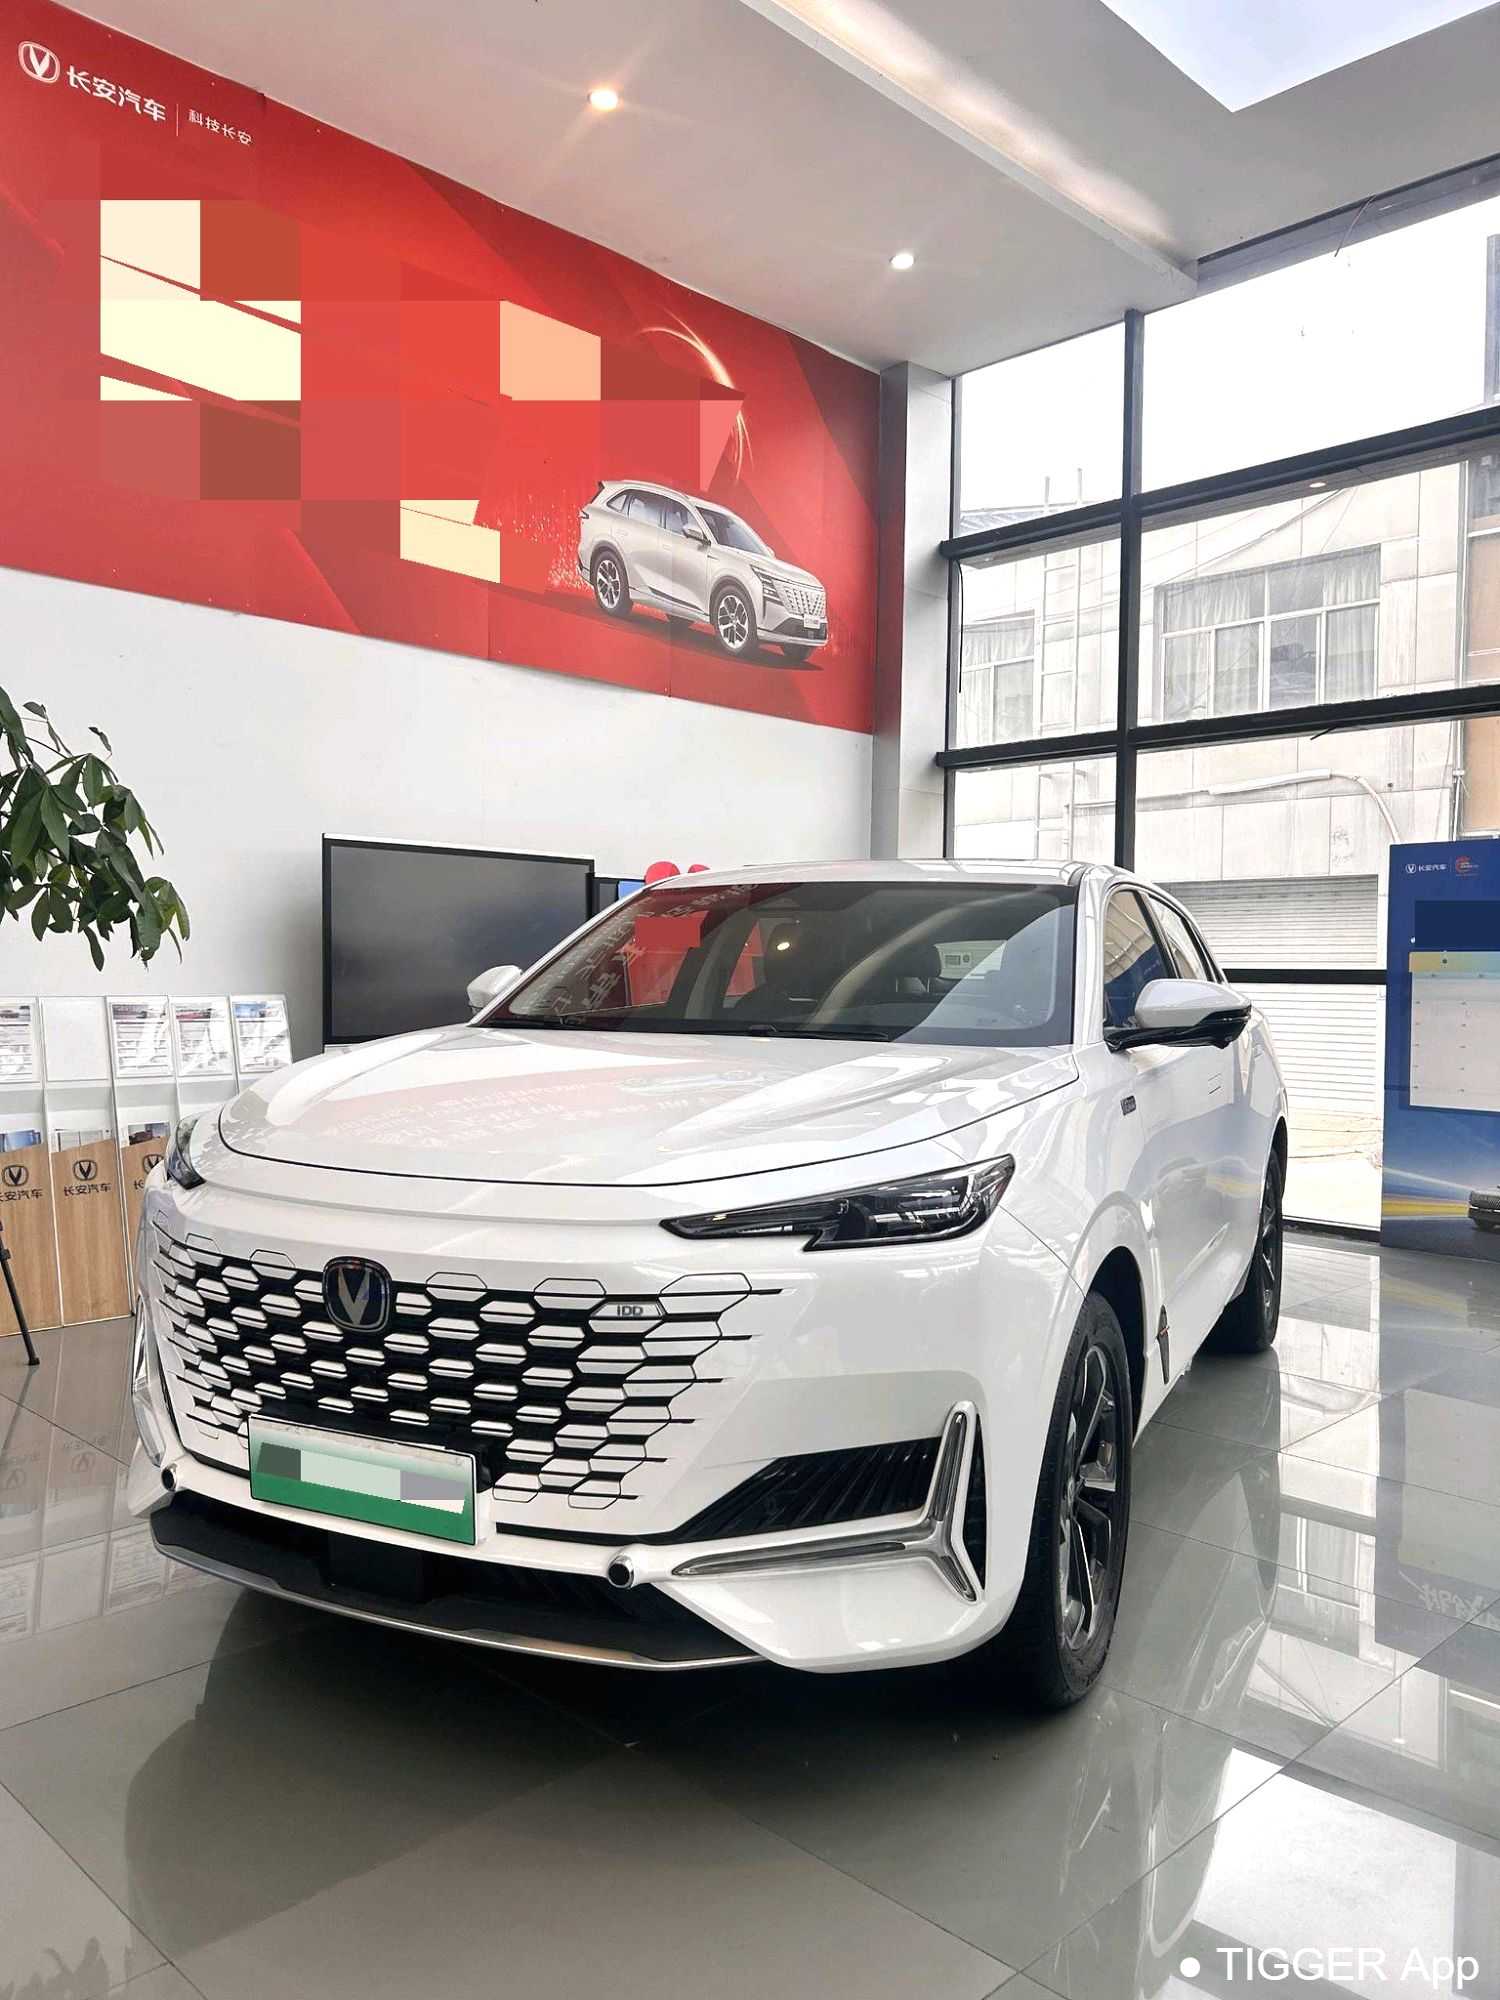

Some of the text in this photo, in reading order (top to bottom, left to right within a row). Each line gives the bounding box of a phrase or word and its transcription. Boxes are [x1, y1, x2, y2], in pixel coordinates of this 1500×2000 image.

[67, 65, 252, 146] 长安汽车 科技长安
[64, 1182, 112, 1197] 长安汽车
